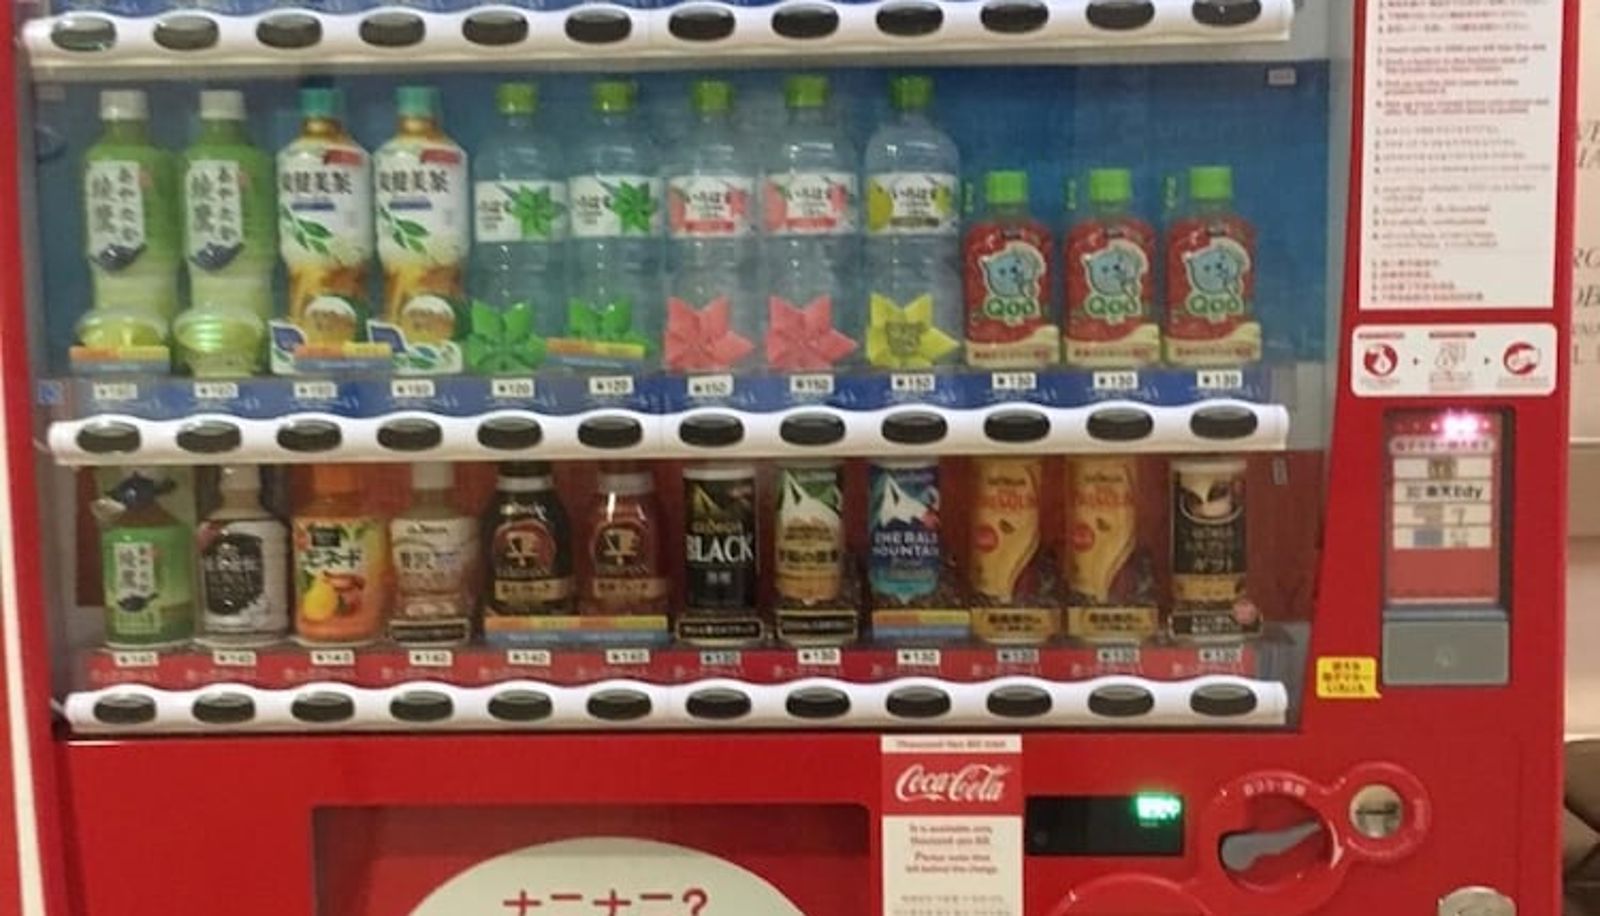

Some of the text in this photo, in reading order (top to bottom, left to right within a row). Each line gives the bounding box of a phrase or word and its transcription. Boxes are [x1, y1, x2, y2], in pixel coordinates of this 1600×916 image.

[986, 296, 1037, 316] Qoo
[1087, 295, 1138, 316] Qoo
[1189, 294, 1239, 314] Qoo
[685, 534, 754, 564] BLACK
